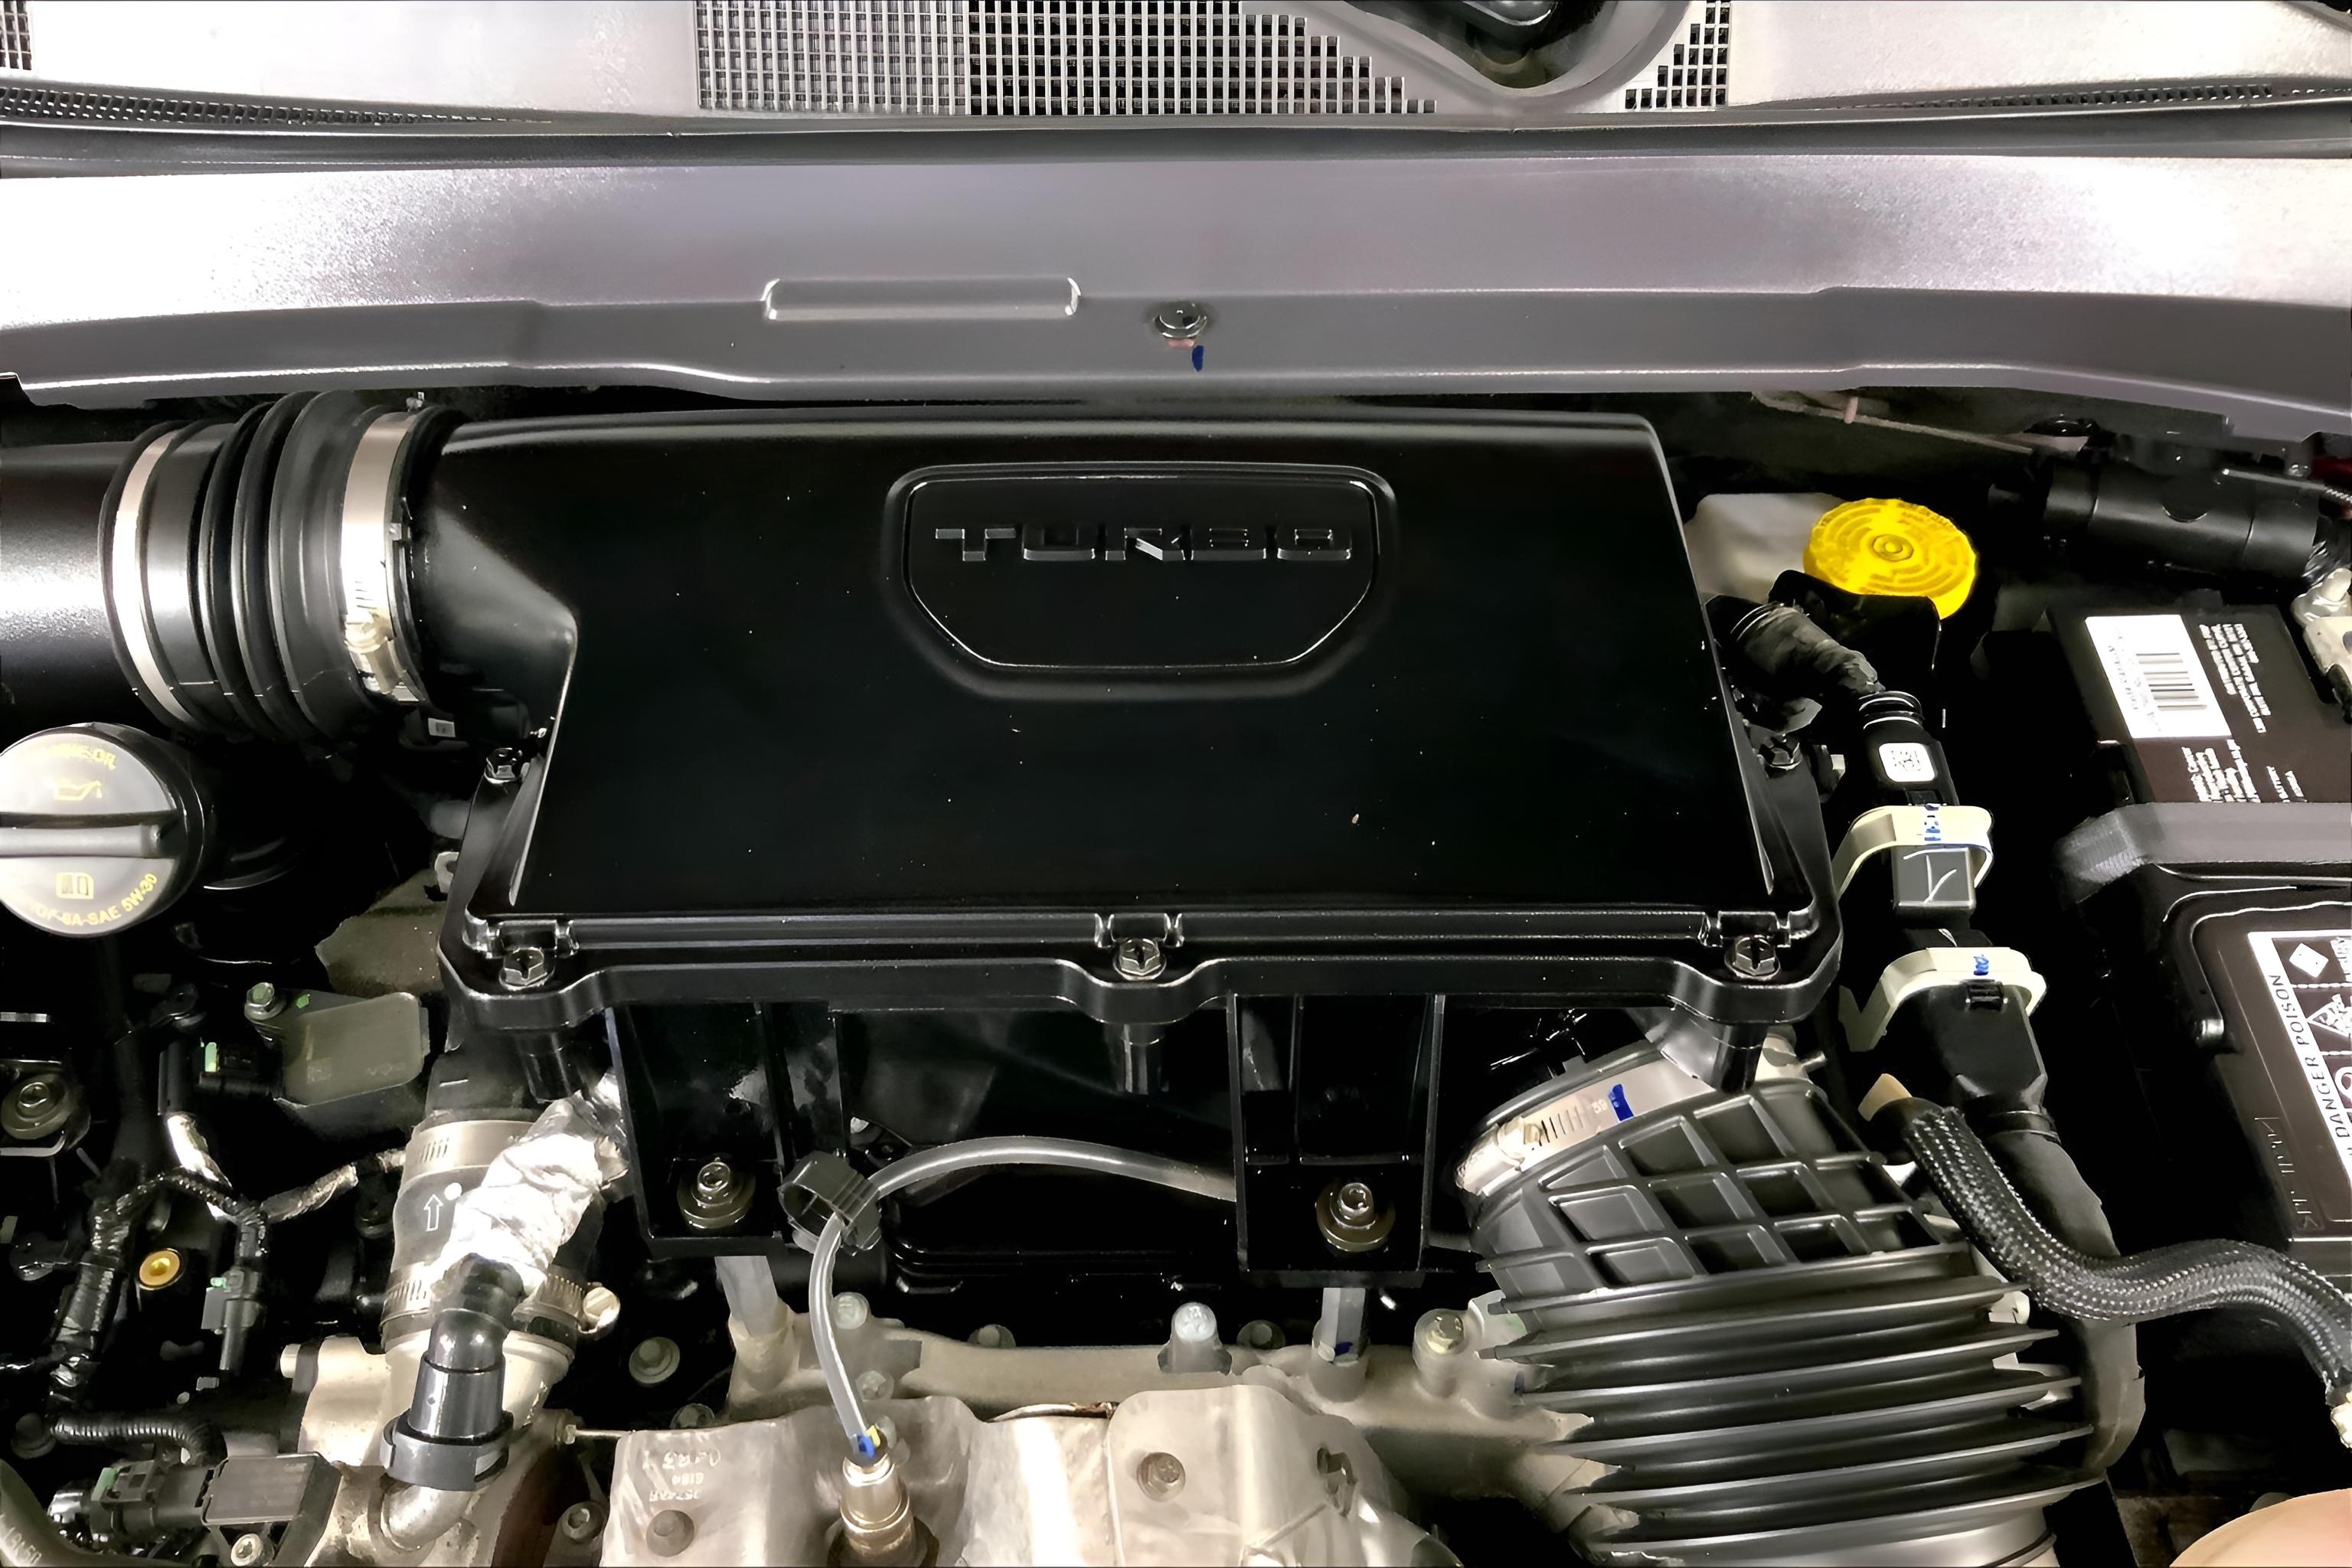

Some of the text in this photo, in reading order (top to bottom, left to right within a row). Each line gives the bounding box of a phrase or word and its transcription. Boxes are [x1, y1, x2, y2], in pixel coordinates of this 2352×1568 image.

[935, 522, 1353, 562] TURBO
[2268, 975, 2350, 1138] DANGER POISON
